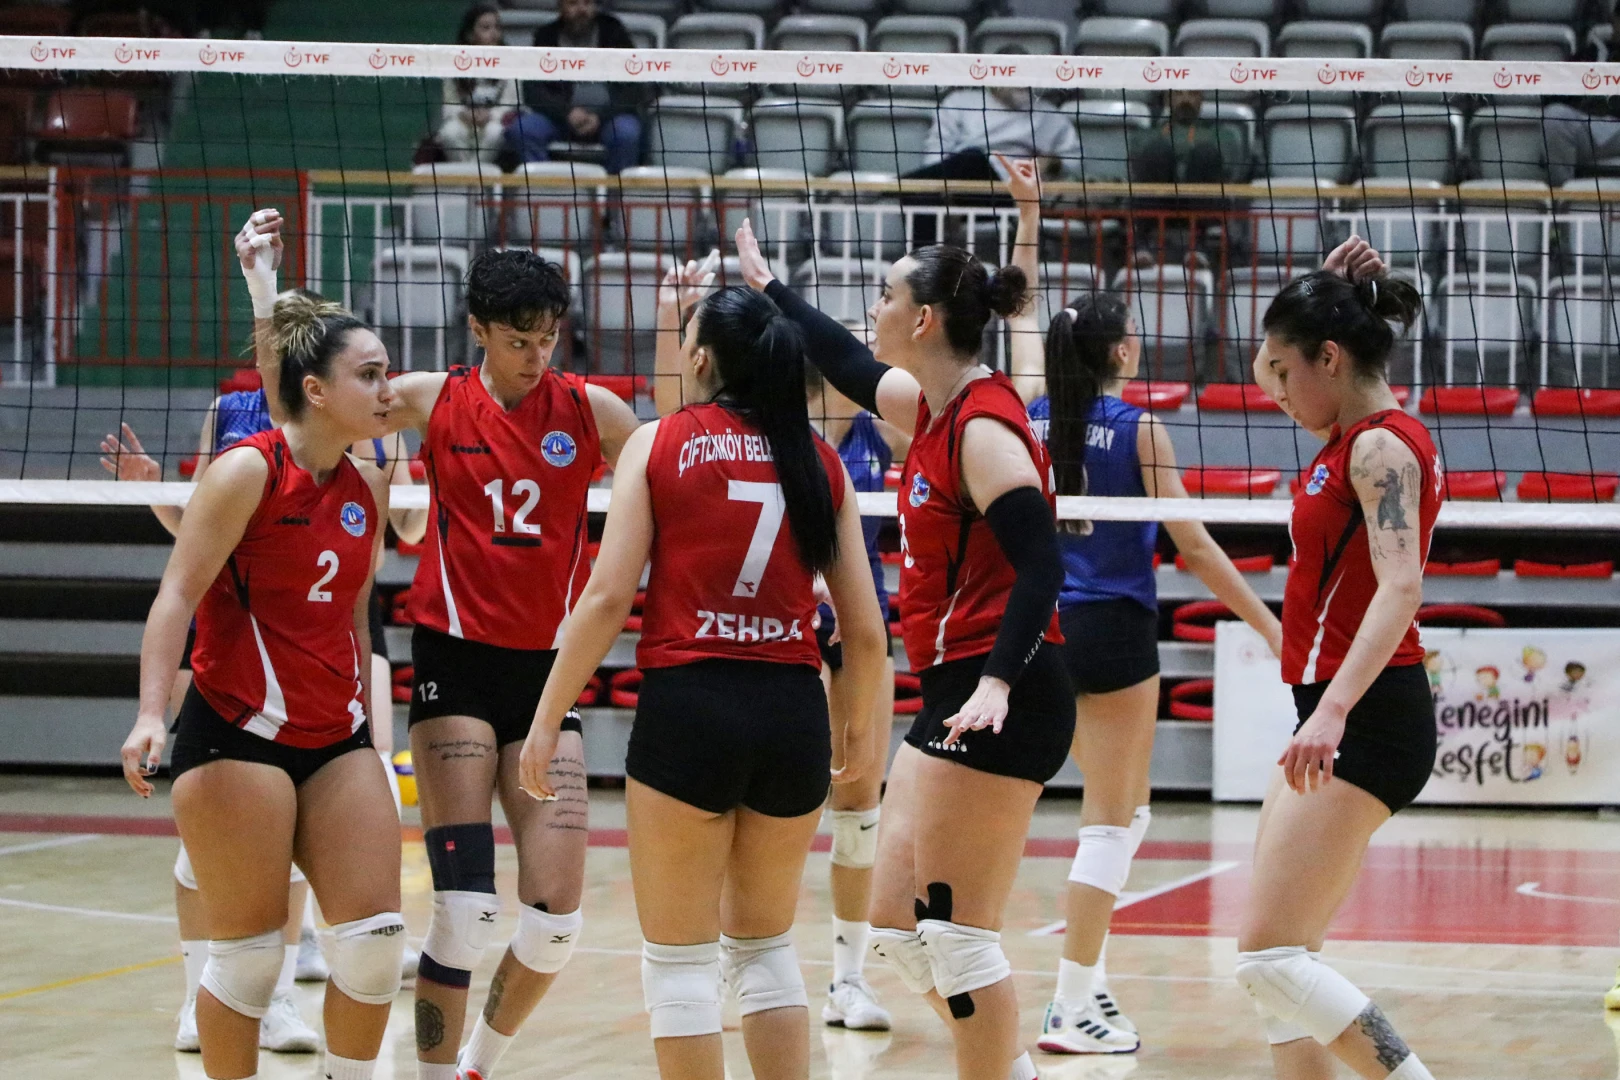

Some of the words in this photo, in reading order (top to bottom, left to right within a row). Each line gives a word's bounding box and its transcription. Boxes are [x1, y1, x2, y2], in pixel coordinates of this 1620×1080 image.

[52, 47, 76, 58] TVF
[135, 49, 160, 59] TVF
[219, 51, 244, 61] TVF
[304, 53, 328, 63] TVF
[390, 55, 415, 65] TVF
[475, 57, 500, 67] TVF
[560, 59, 586, 69] TVF
[646, 61, 671, 71] TVF
[731, 62, 757, 71] TVF
[818, 63, 843, 73] TVF
[904, 64, 929, 74] TVF
[990, 66, 1016, 76] TVF
[1077, 67, 1103, 77] TVF
[1164, 68, 1189, 78] TVF
[1251, 69, 1277, 80] TVF
[1338, 70, 1366, 81] TVF
[1426, 72, 1452, 82] TVF
[1515, 74, 1541, 84] TVF
[1604, 75, 1620, 85] TV
[484, 478, 541, 535] 12
[727, 479, 787, 598] 7
[307, 550, 340, 602] 2
[694, 609, 803, 643] ZEHRA
[419, 681, 439, 702] 12
